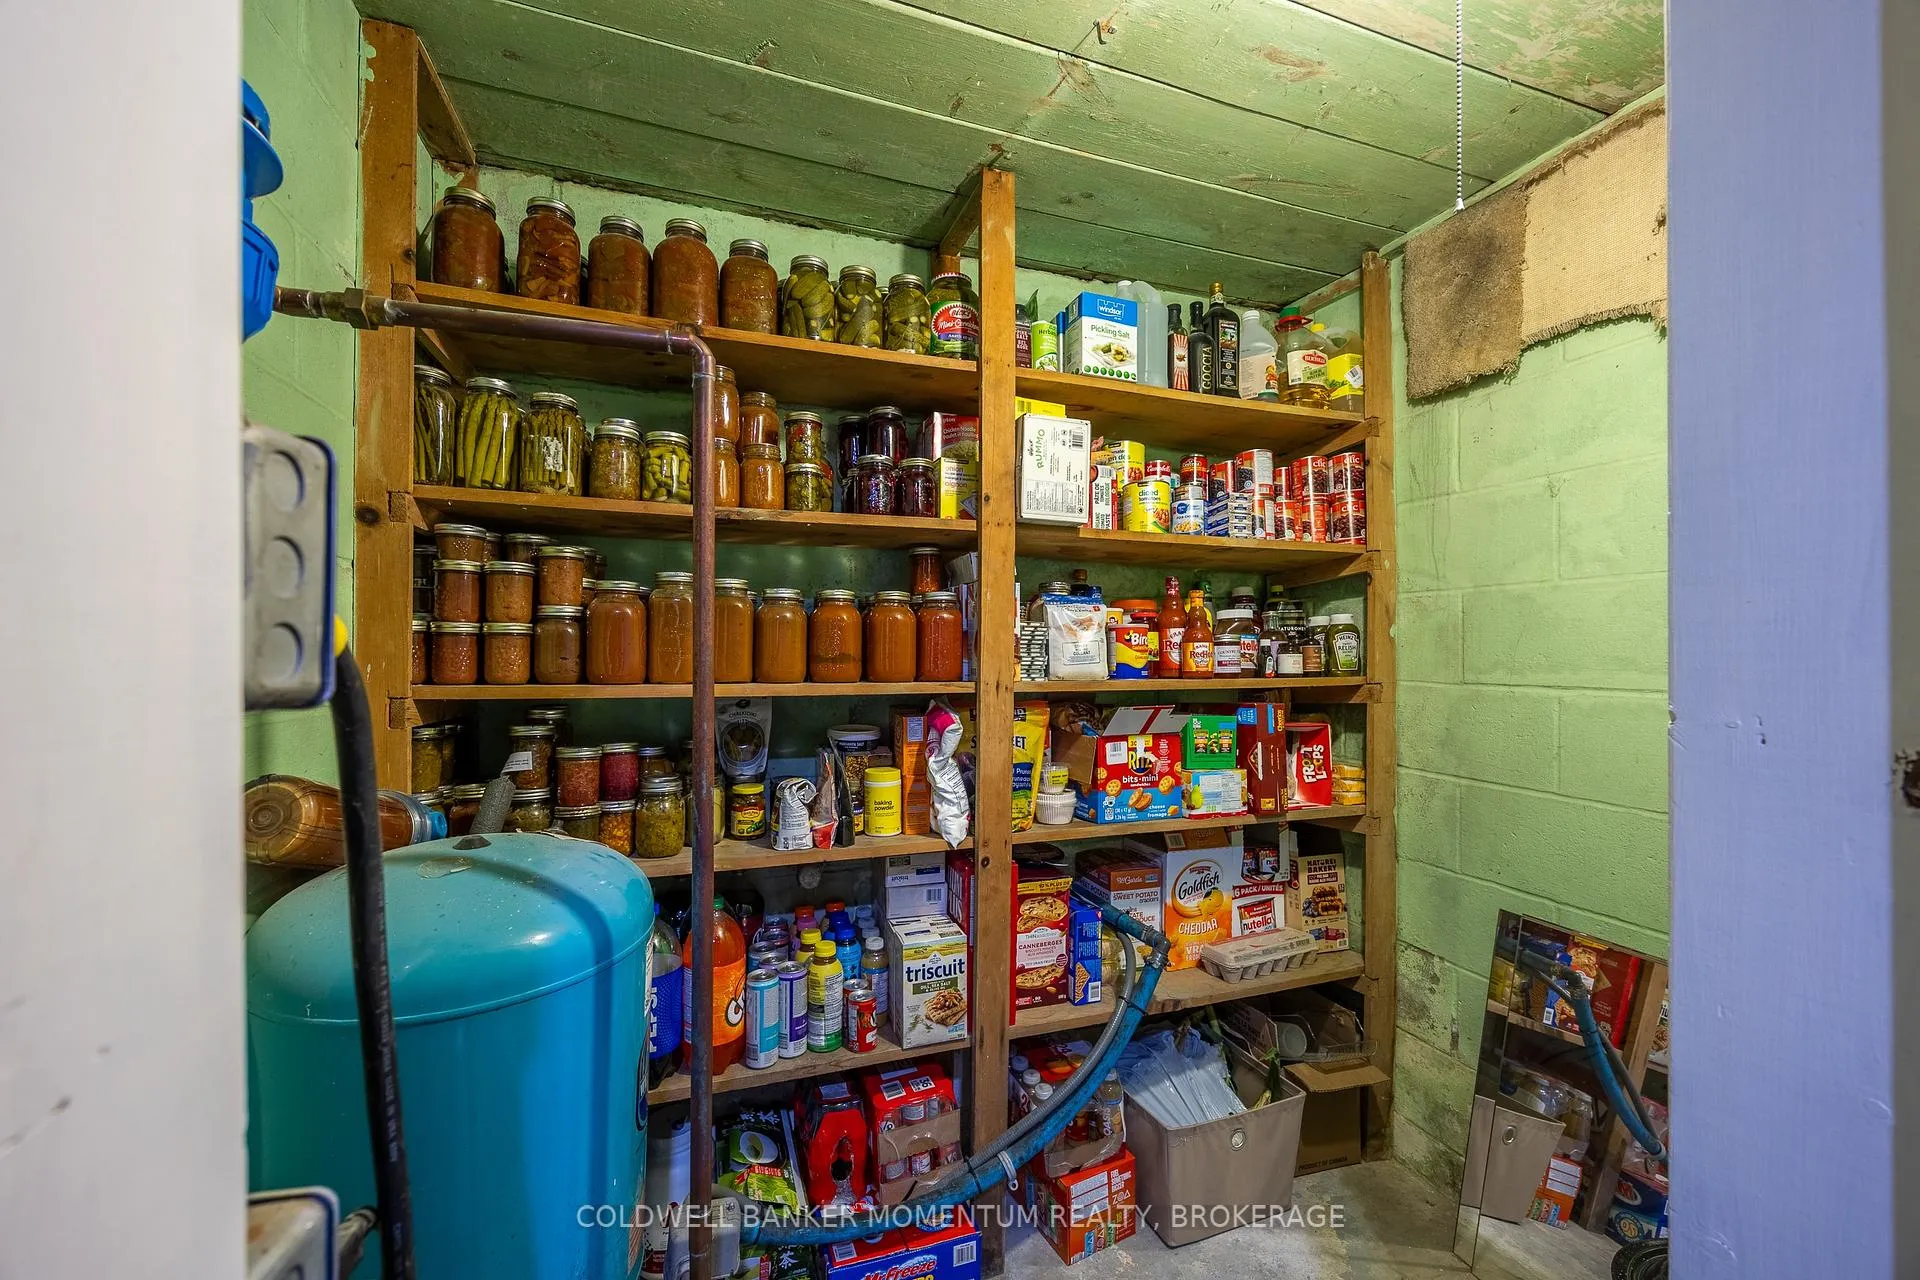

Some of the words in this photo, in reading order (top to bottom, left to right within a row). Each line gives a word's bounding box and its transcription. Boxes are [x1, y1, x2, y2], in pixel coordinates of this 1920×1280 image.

[1099, 305, 1123, 316] windsor
[1090, 324, 1117, 337] Pickling
[1117, 330, 1130, 339] Salt
[1202, 346, 1212, 390] GOCCIA
[1036, 429, 1046, 469] RUMMO
[1313, 456, 1326, 468] clic
[1307, 865, 1337, 873] BAKERY
[1179, 871, 1220, 901] Goldfish
[1240, 886, 1257, 895] PACK
[1262, 883, 1284, 892] UNITÉS
[1113, 893, 1134, 901] SWEET
[1135, 890, 1159, 899] POTATO
[1178, 918, 1218, 936] CHEDDAR
[1243, 915, 1272, 931] nutella
[1018, 939, 1063, 950] CANNEBERGES
[905, 958, 966, 982] triscuit
